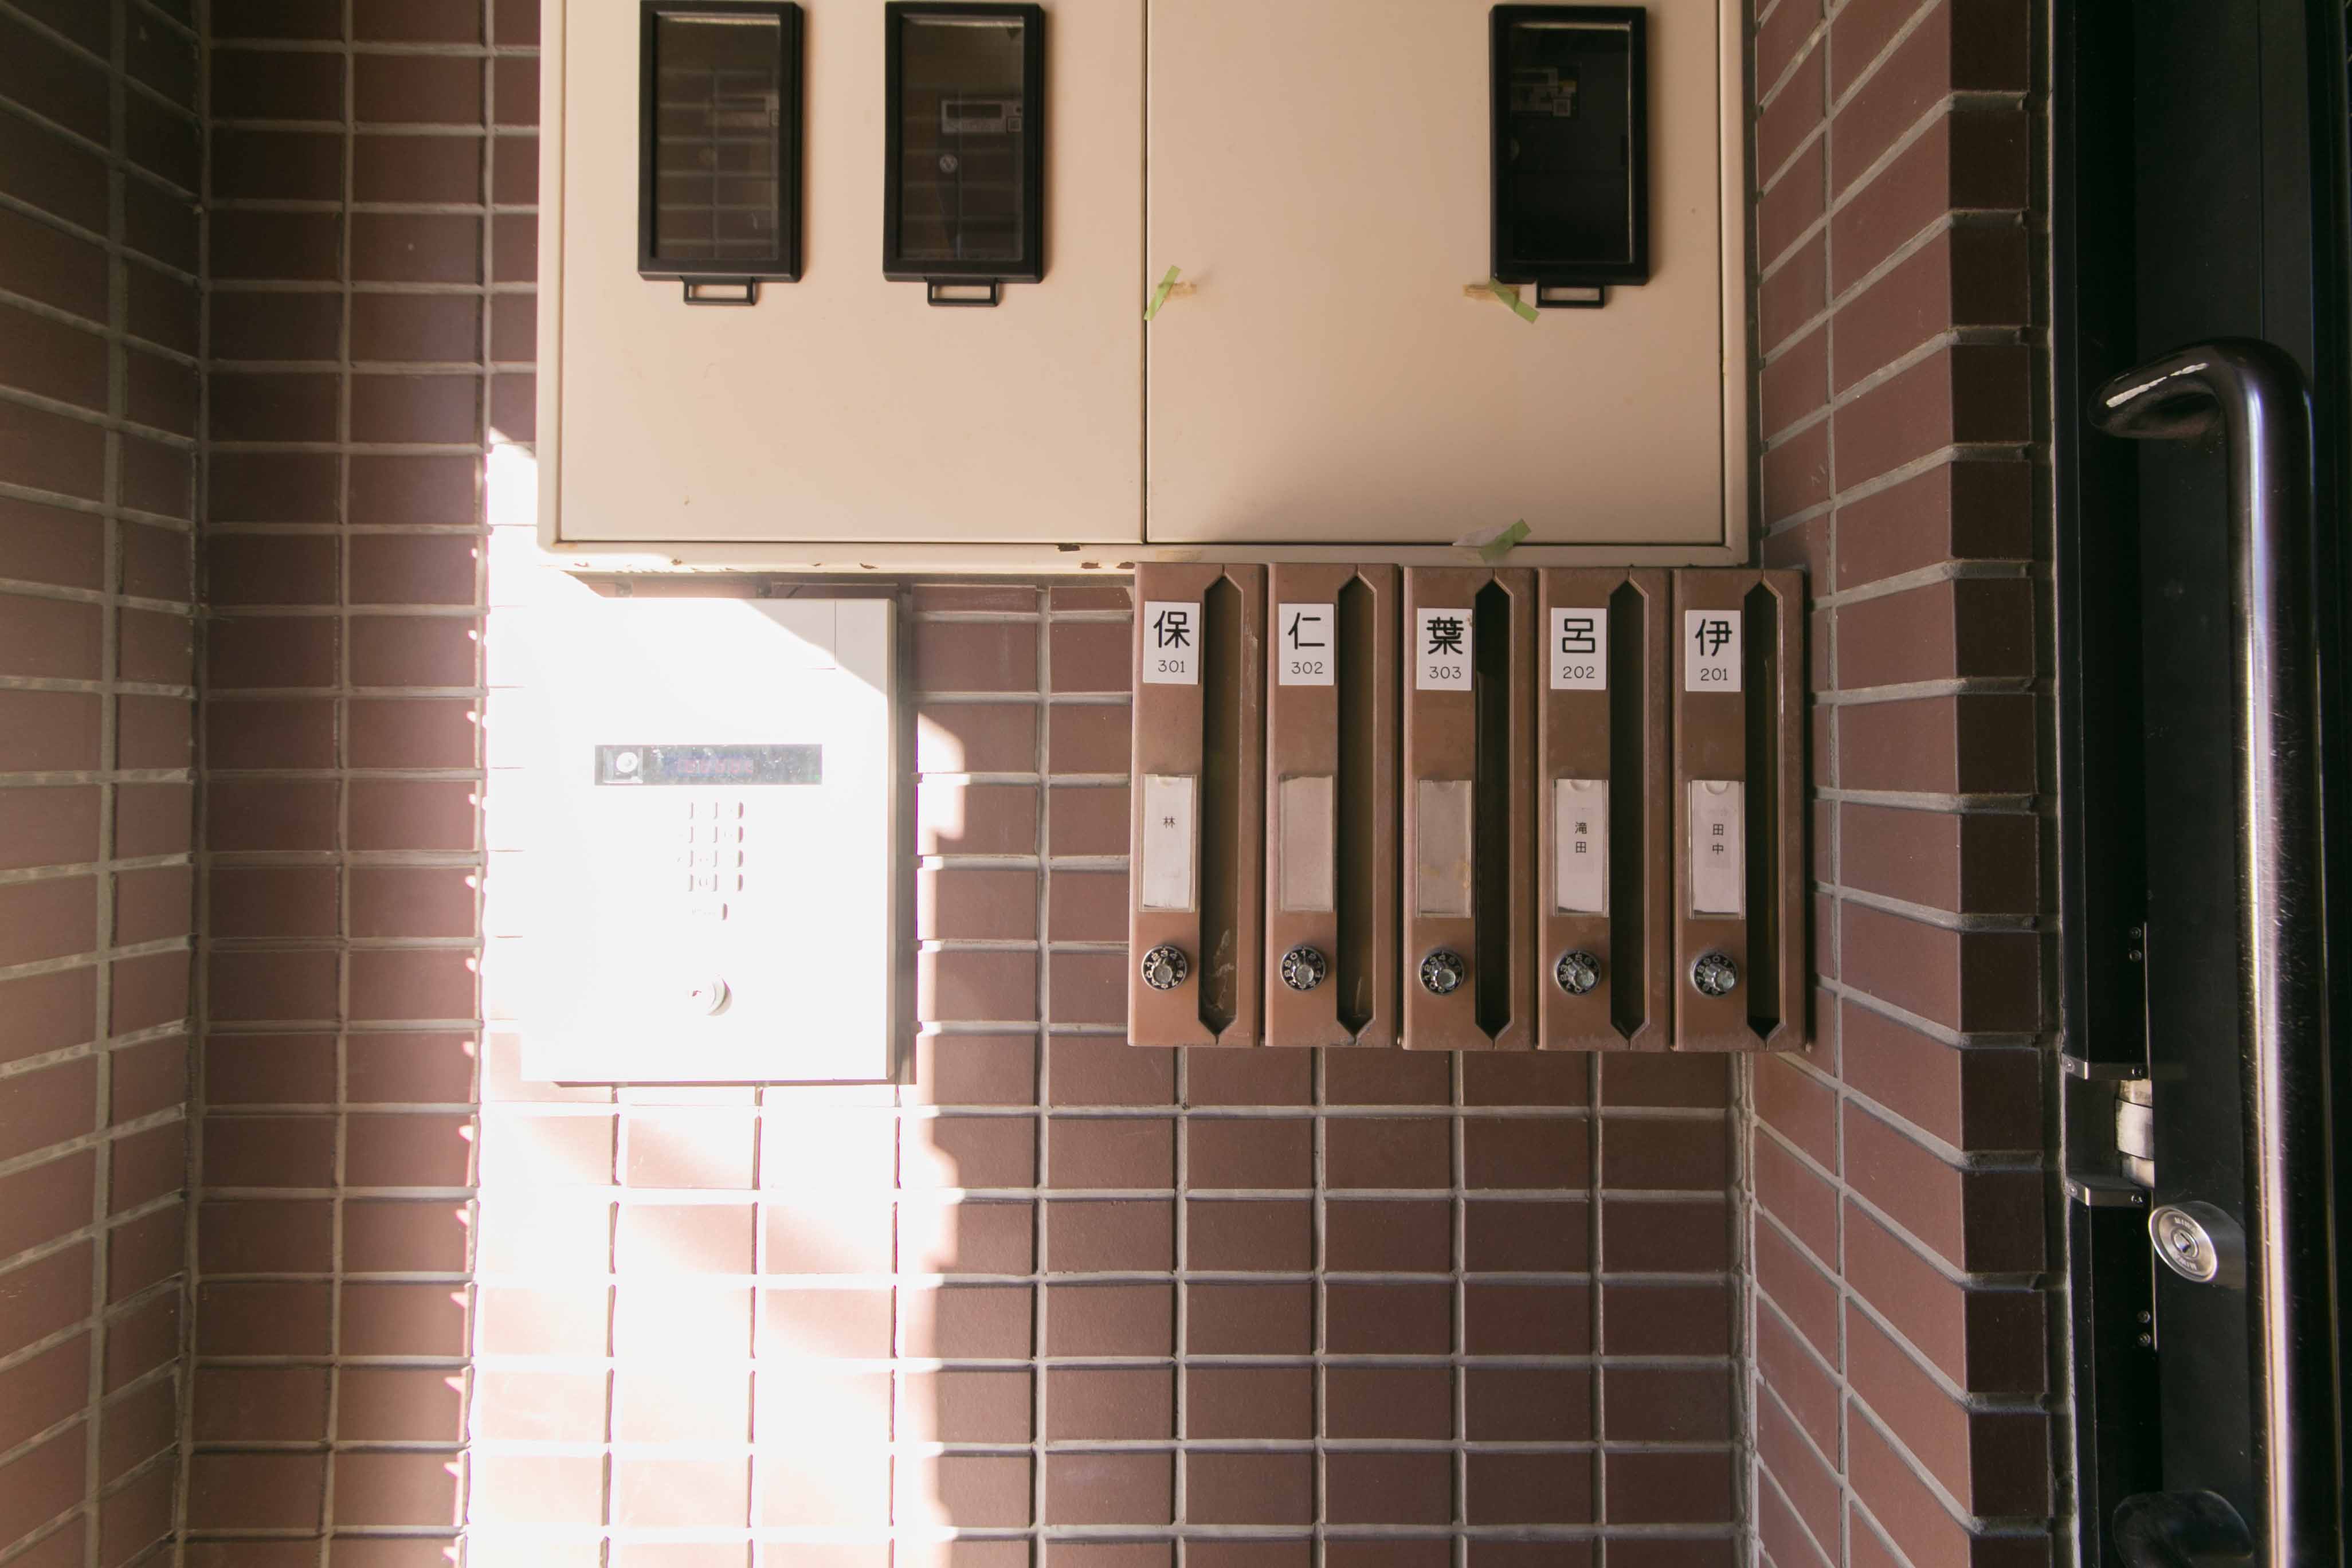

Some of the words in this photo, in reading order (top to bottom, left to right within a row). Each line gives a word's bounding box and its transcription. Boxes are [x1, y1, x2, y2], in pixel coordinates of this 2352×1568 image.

[1153, 610, 1190, 649] 保
[1288, 612, 1326, 650] 仁
[1426, 616, 1464, 655] 葉
[1562, 618, 1596, 654] 呂
[1695, 618, 1732, 657] 伊
[1158, 660, 1185, 673] 301
[1291, 661, 1323, 675] 302
[1429, 666, 1461, 679] 303
[1563, 666, 1595, 679] 202
[1700, 668, 1728, 681] 201
[1163, 816, 1176, 828] 林
[1574, 821, 1587, 853] 滝田
[1711, 823, 1724, 856] 田中
[1151, 952, 1160, 961] 2
[1284, 959, 1292, 968] 9
[1290, 952, 1298, 961] 0
